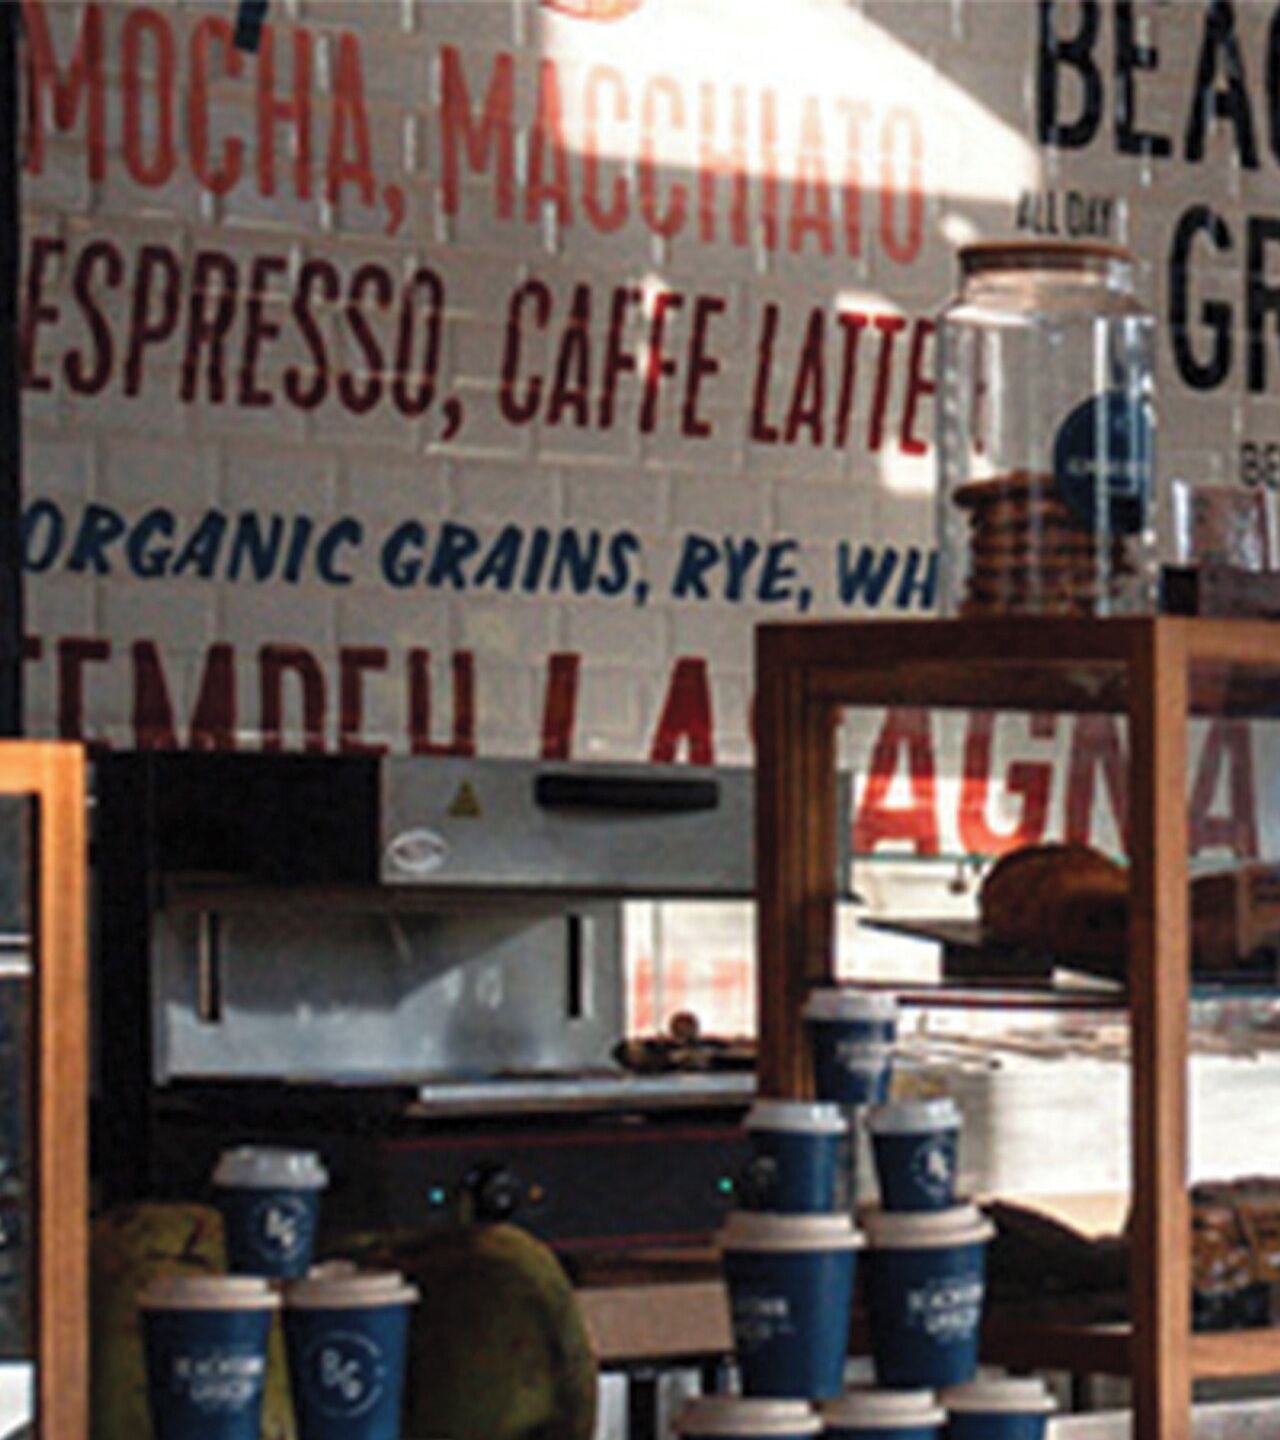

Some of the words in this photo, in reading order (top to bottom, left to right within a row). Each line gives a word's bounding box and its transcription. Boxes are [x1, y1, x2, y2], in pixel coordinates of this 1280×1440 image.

[22, 0, 404, 234] MOCHA,
[438, 44, 925, 266] MACCHIATO
[20, 236, 462, 440] ESPRESSO,
[500, 278, 727, 438] CAFFE
[22, 498, 363, 586] ORGANIC
[380, 519, 650, 605] GRAINS,
[671, 534, 812, 611] RYE,
